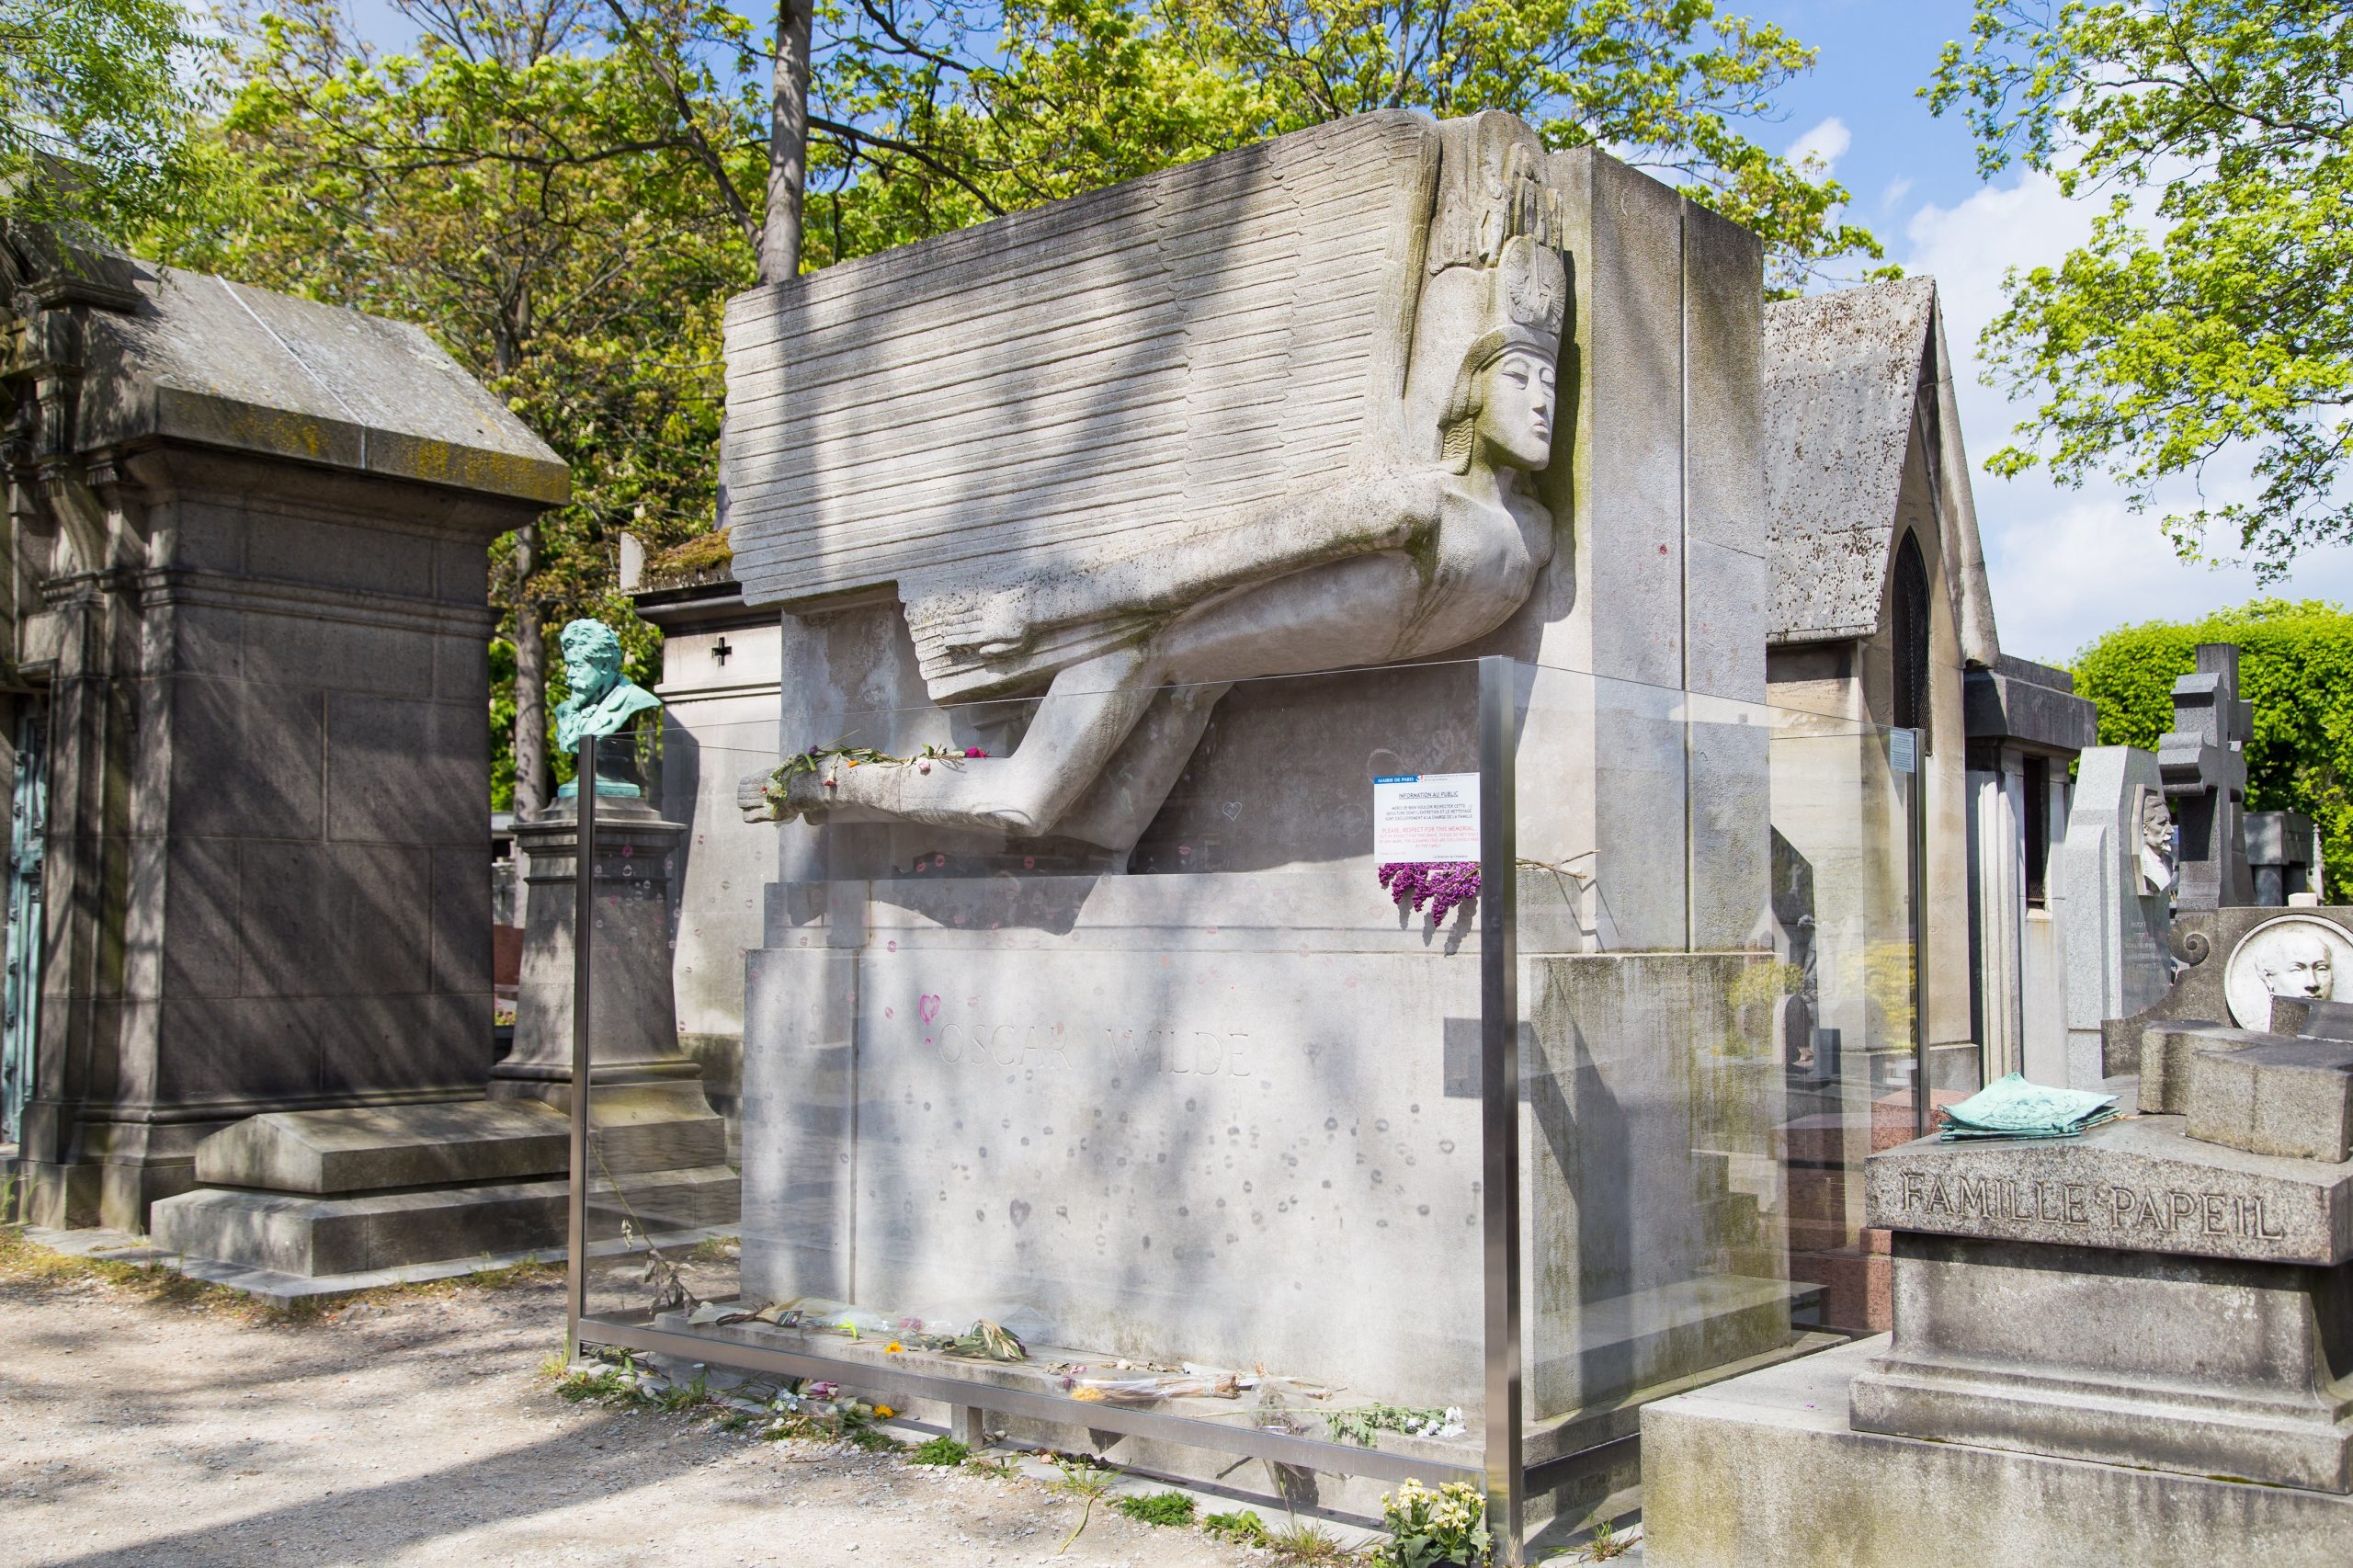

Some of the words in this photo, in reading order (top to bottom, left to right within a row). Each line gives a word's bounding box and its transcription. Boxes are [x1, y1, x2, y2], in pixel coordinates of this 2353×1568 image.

[938, 1022, 1074, 1070] OSCAR
[1106, 1028, 1251, 1078] WILDE
[1900, 1171, 2088, 1226] FAMILLE
[2109, 1186, 2284, 1242] PAPEIL
